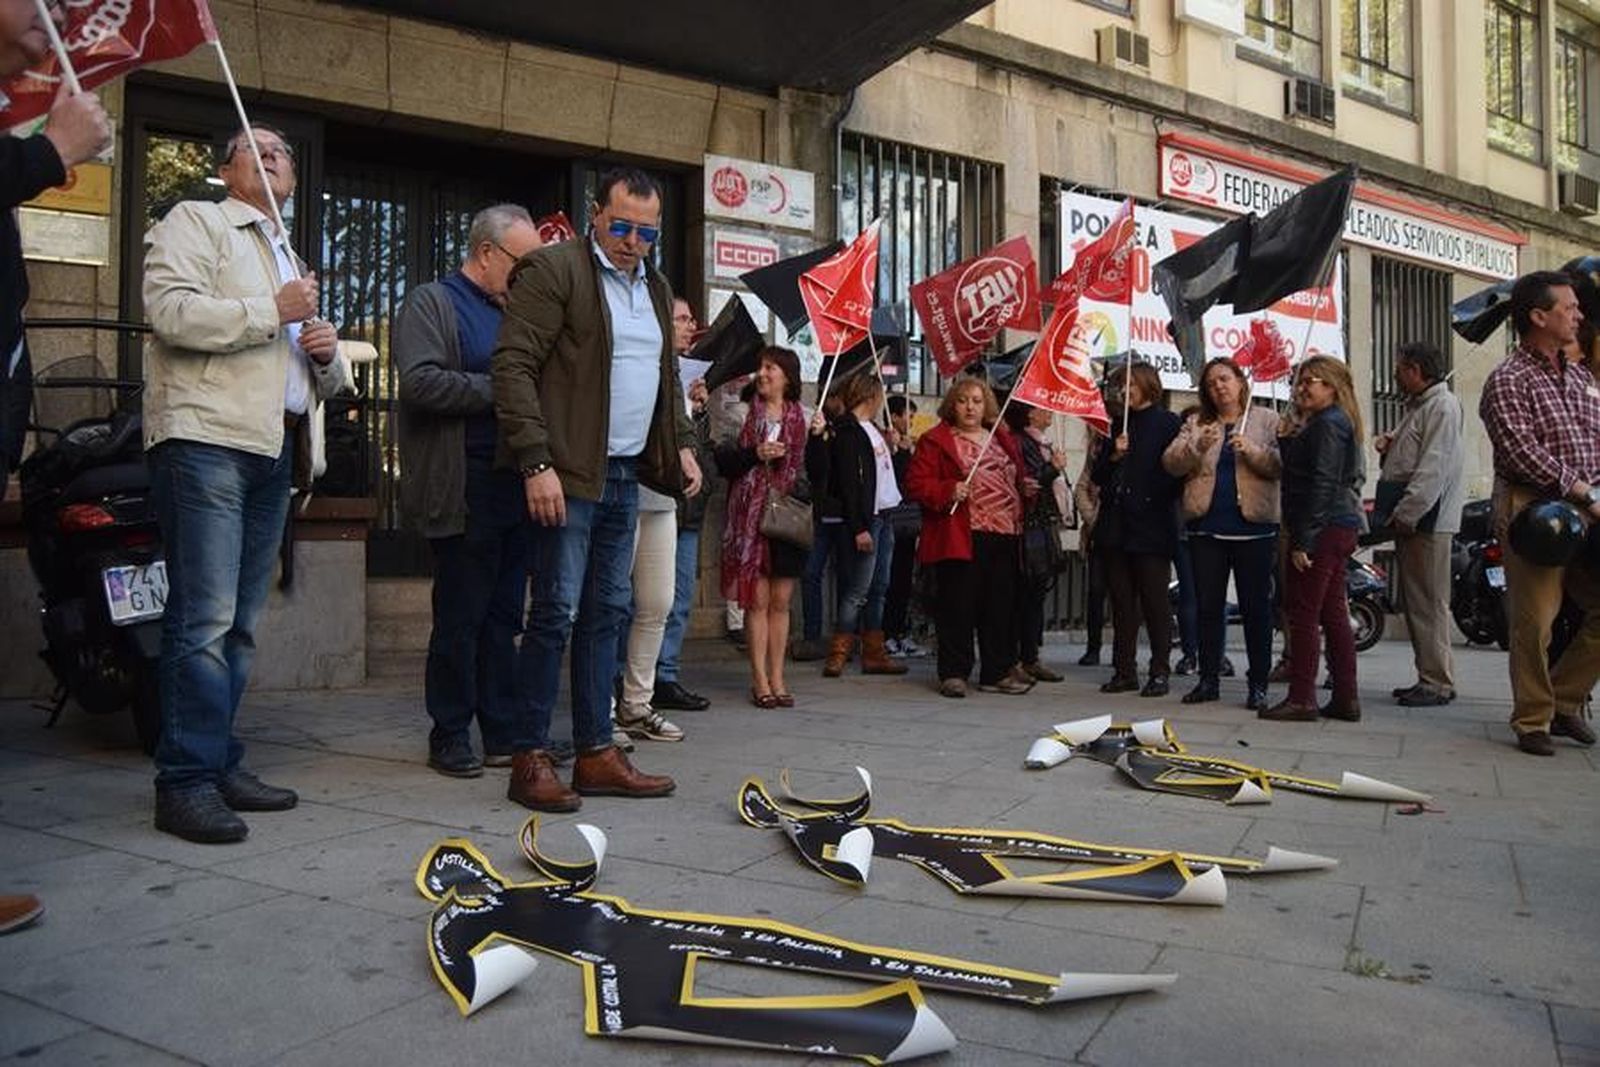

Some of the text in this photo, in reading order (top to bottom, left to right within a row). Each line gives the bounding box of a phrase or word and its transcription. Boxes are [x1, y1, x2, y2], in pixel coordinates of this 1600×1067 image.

[1222, 172, 1297, 213] FEDERAC
[1402, 221, 1462, 262] SERVICIOS
[885, 960, 910, 972] EN
[913, 964, 1014, 989] SALAMANCA
